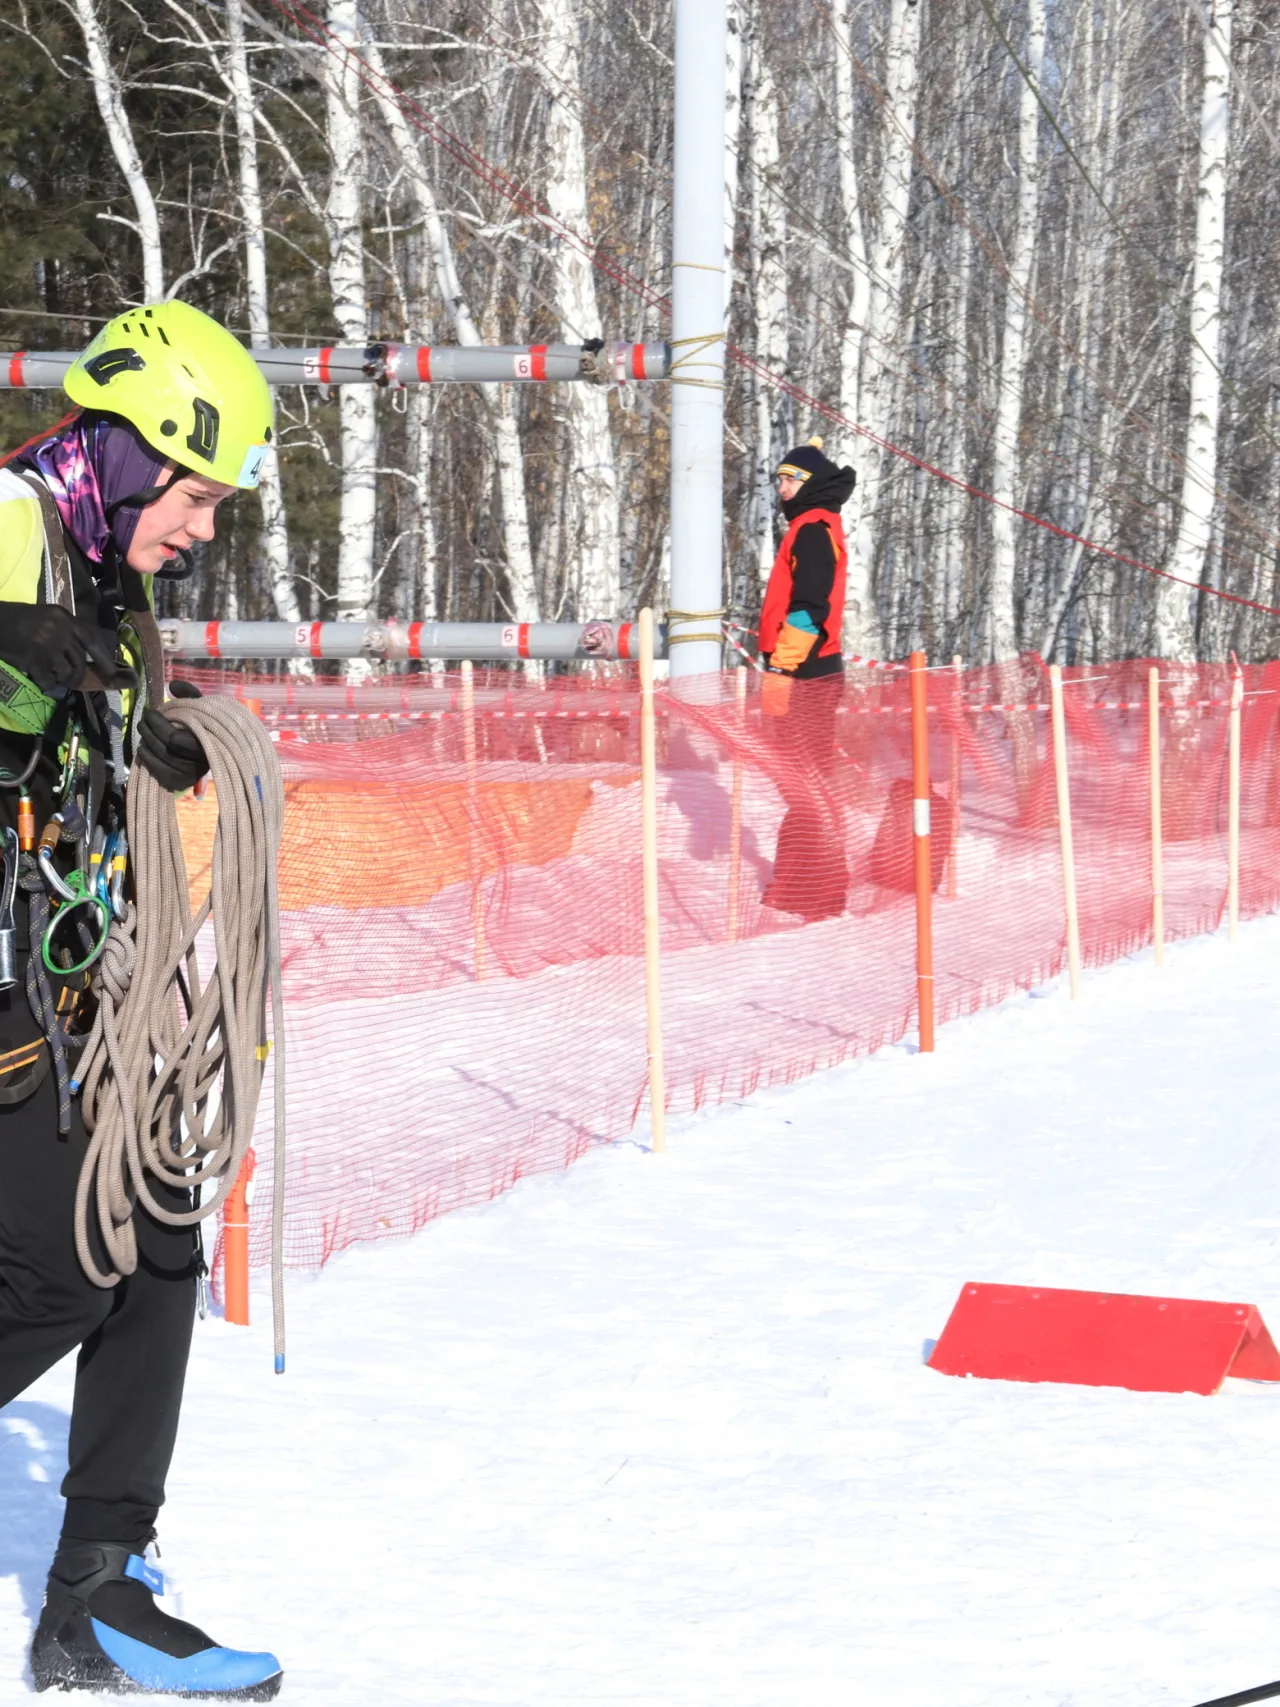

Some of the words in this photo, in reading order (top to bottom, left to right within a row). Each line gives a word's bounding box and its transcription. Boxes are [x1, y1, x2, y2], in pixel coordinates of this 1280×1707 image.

[305, 360, 314, 374] 5
[518, 360, 528, 374] 6
[297, 629, 306, 643] 5
[504, 629, 513, 643] 6
